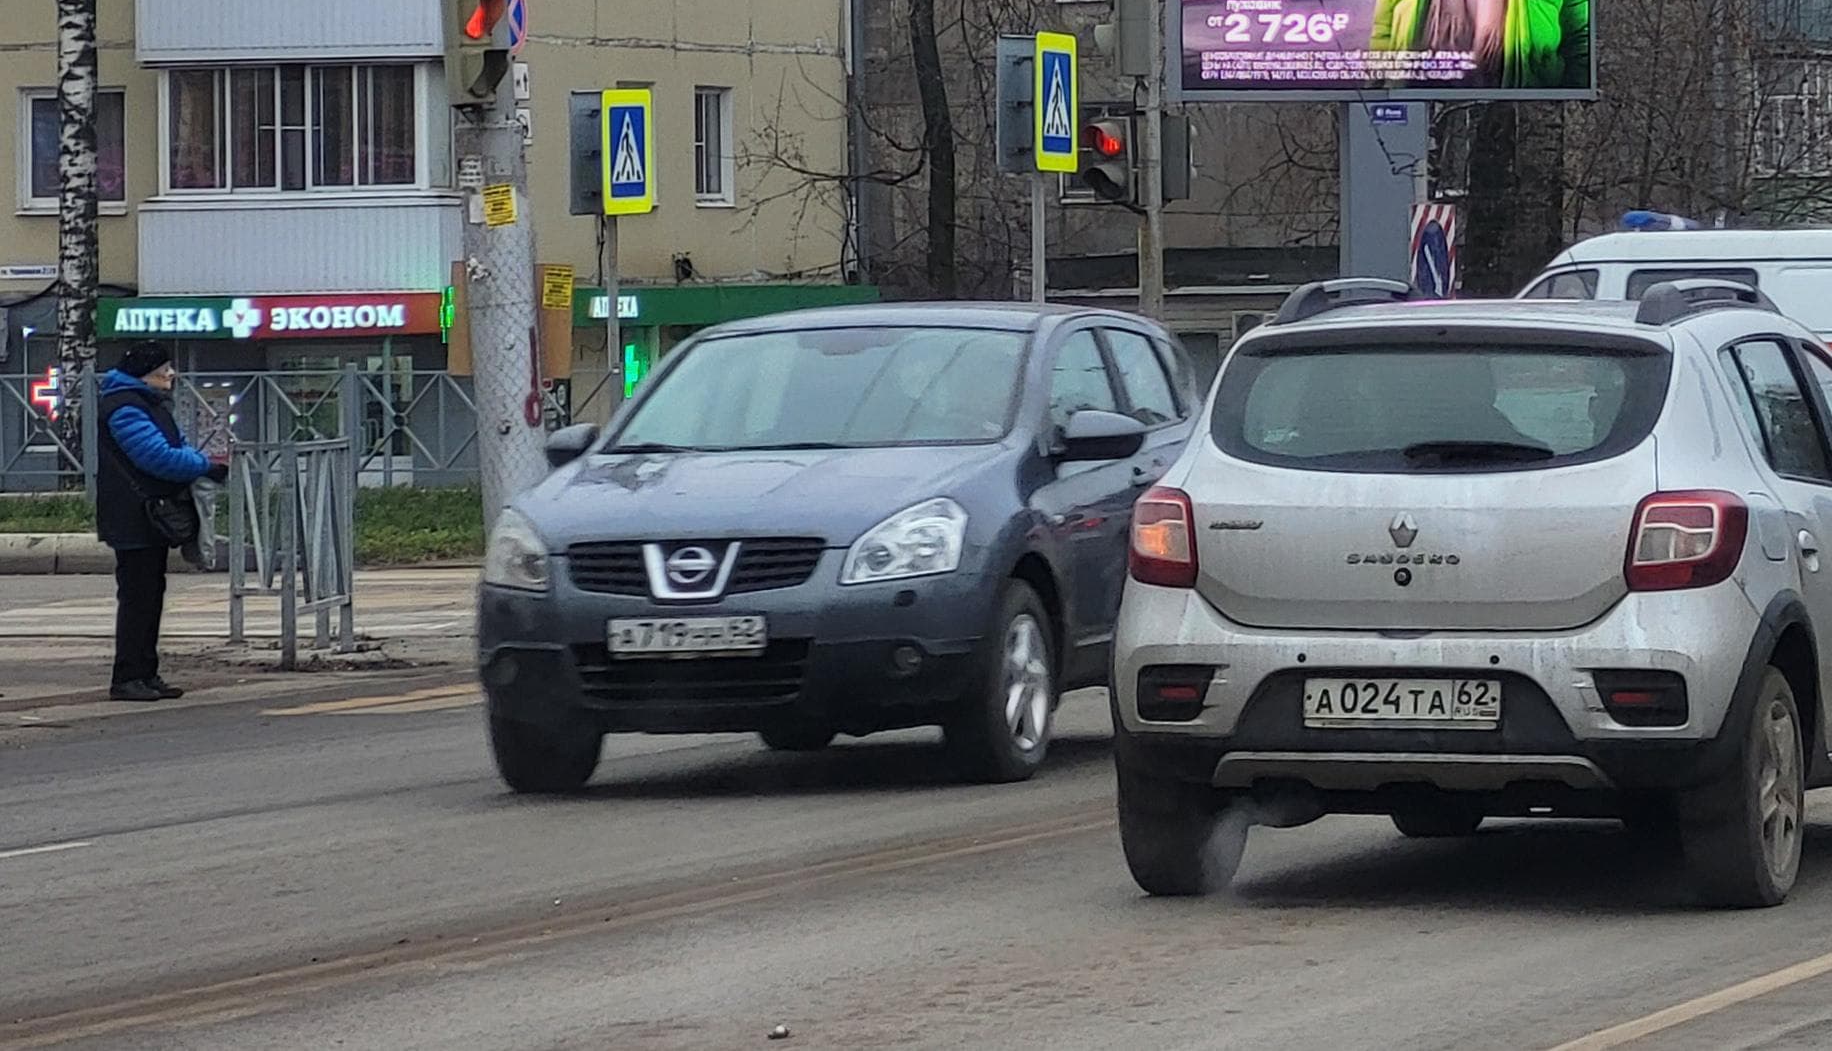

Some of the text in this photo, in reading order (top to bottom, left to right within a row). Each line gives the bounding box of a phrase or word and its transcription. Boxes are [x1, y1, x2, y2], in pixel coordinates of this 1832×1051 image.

[1207, 15, 1224, 27] от
[114, 304, 405, 332] АПТЕКА ЭКОНОМ
[590, 295, 639, 319] АПЕКА
[1457, 680, 1490, 706] 62
